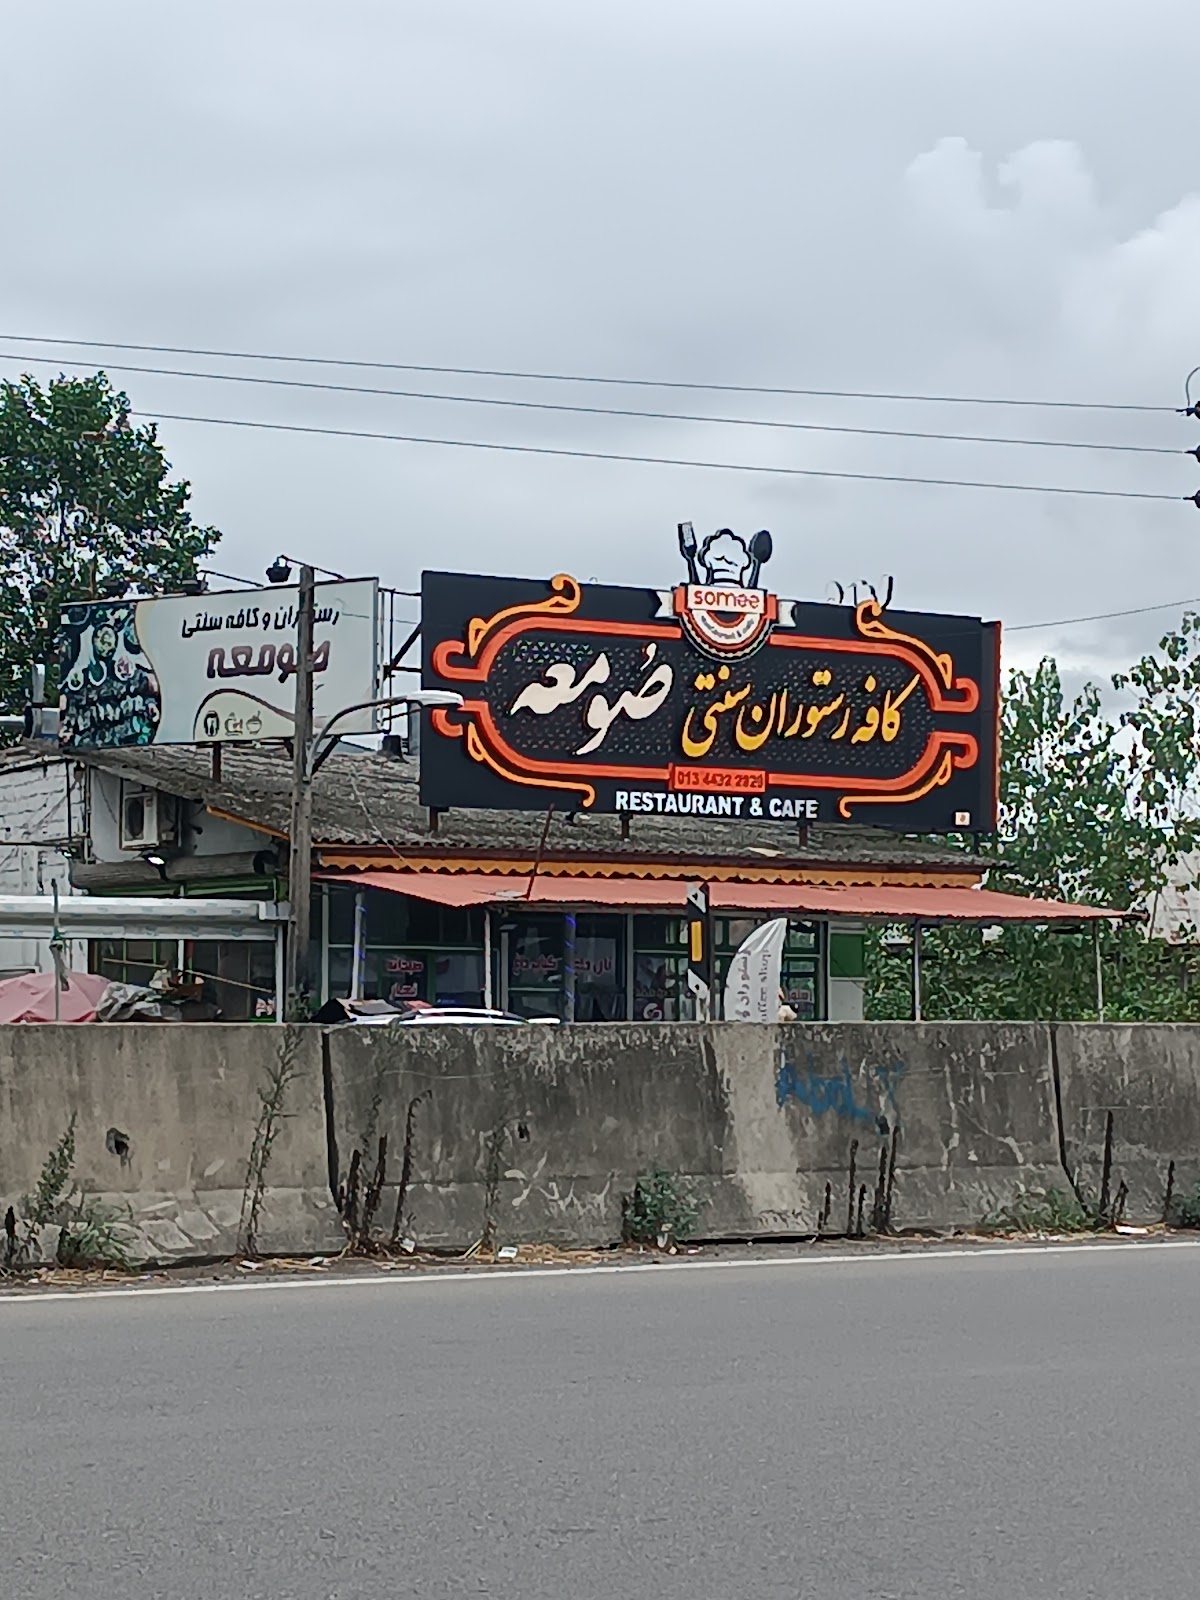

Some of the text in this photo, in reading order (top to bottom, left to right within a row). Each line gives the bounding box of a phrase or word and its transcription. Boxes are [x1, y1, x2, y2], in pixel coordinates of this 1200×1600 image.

[694, 590, 760, 609] somee
[226, 607, 260, 629] کافه
[262, 611, 271, 631] و
[274, 603, 340, 630] رسران
[681, 664, 921, 757] کافه رستوران سنتی
[677, 770, 699, 785] 013
[615, 791, 820, 819] RESTAURANT & CAFE
